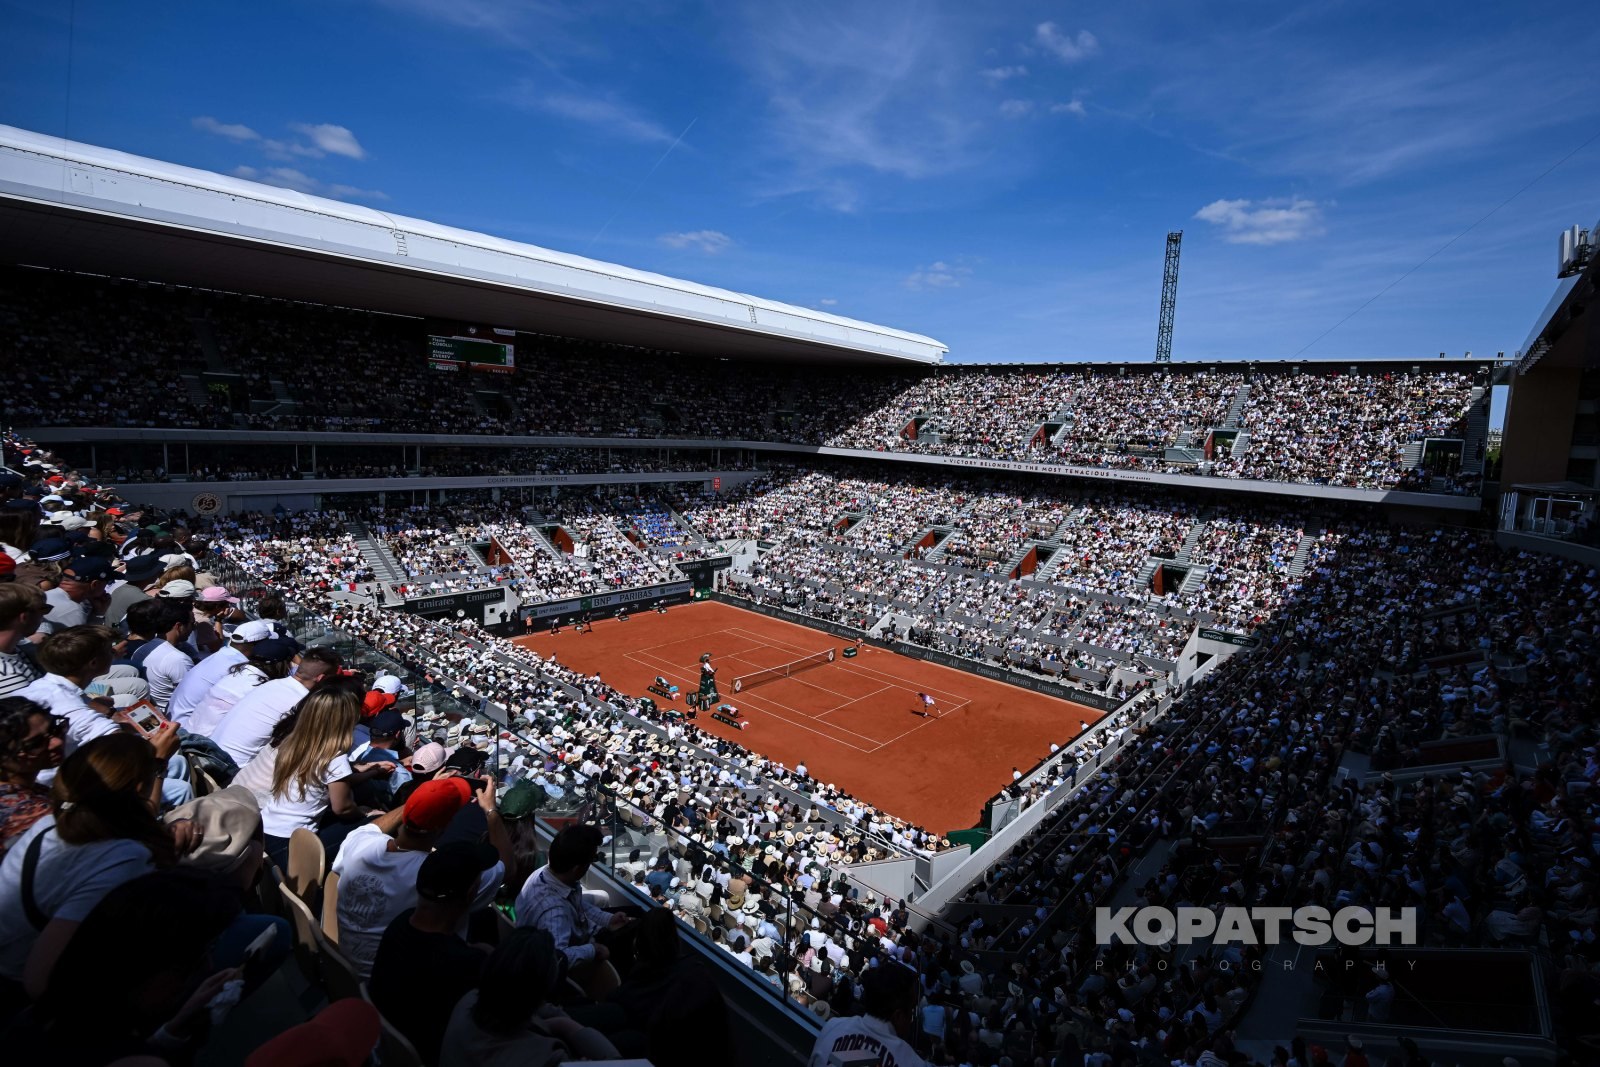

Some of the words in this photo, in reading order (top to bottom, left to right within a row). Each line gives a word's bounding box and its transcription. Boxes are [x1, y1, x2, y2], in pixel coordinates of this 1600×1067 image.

[1065, 468, 1110, 477] TENACIOUS
[466, 591, 501, 602] Emirates
[594, 596, 612, 606] BNP
[620, 590, 652, 602] PARIBAS
[417, 598, 454, 610] Emirates
[806, 620, 828, 630] RENAULT
[837, 628, 860, 638] RENAULT
[924, 652, 934, 660] All
[949, 659, 959, 668] All
[976, 666, 1001, 679] Emirates
[1006, 674, 1032, 687] Emirates
[1037, 682, 1064, 696] Emirates
[1070, 691, 1099, 706] Emirates
